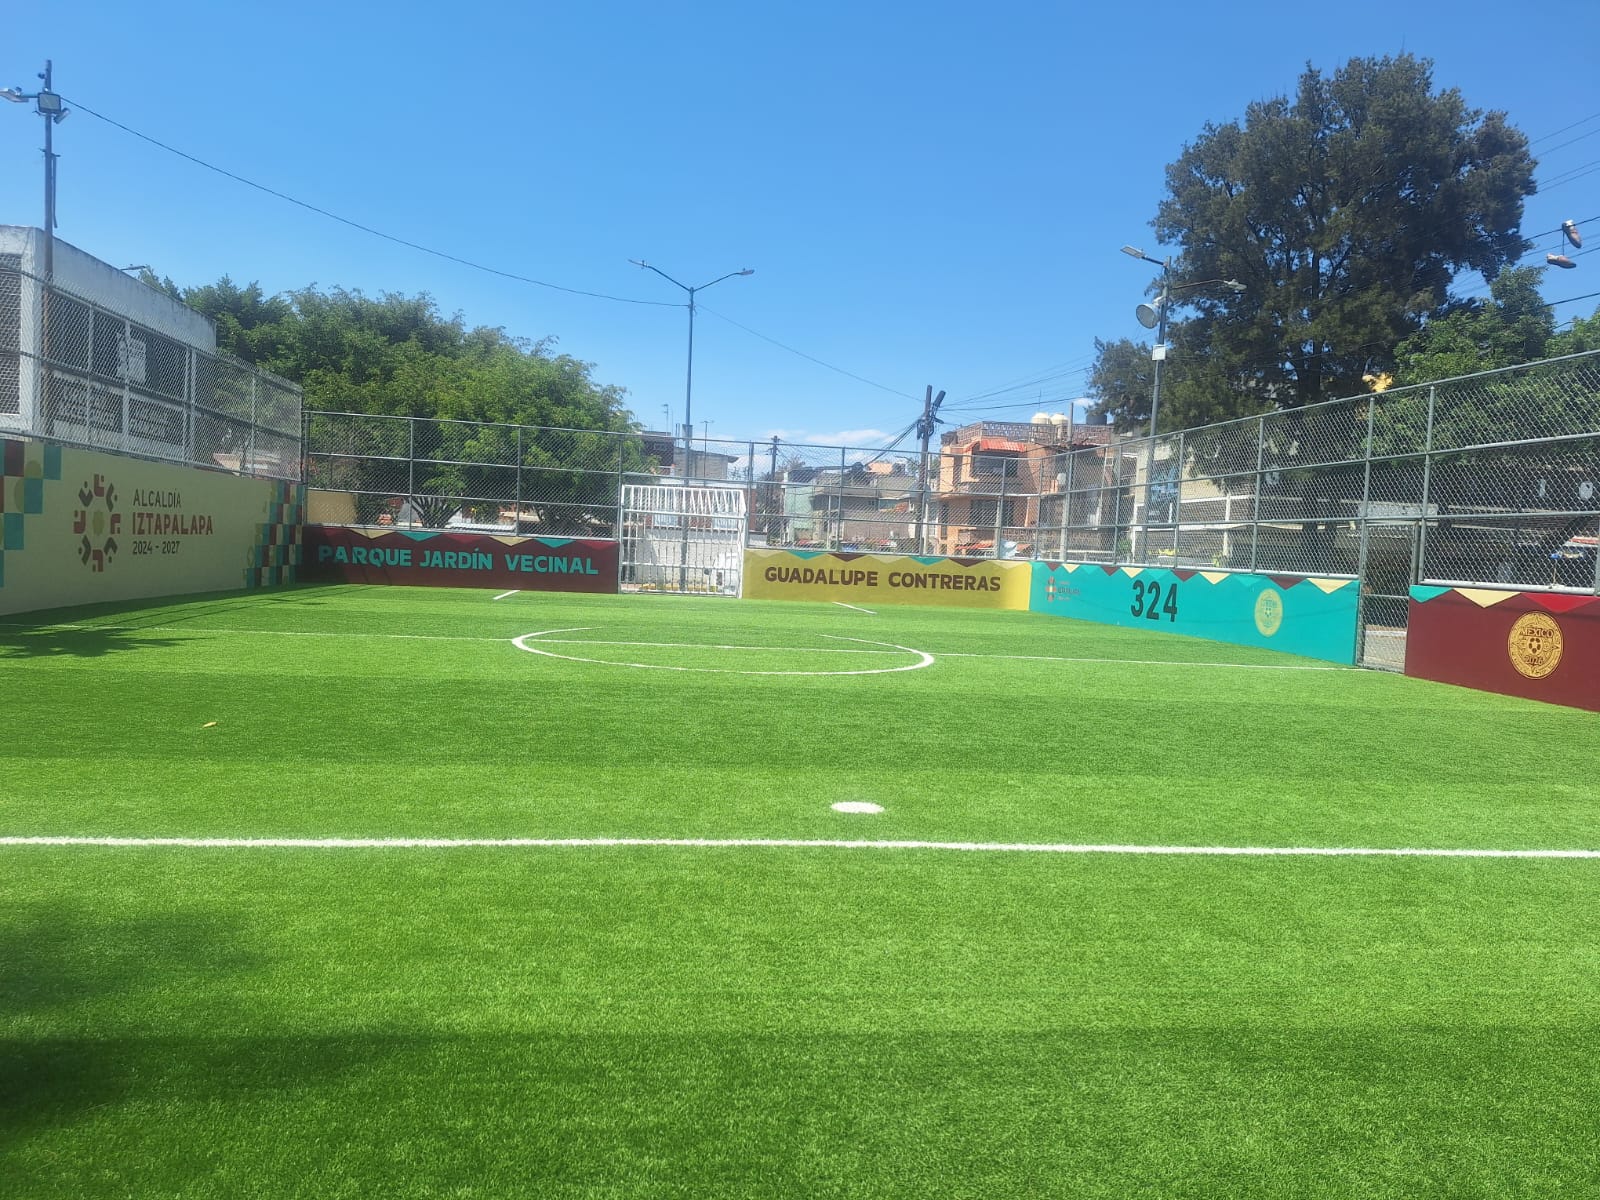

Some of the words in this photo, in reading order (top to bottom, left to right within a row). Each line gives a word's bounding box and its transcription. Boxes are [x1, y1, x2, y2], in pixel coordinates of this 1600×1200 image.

[132, 487, 181, 508] ALCALDÍA
[132, 512, 213, 535] IZTAPALAPA
[132, 541, 152, 554] 2024
[162, 541, 180, 554] 2027
[319, 545, 412, 567] PARQUE
[420, 548, 493, 570] JARDÍN
[505, 554, 599, 575] VECINAL
[765, 566, 878, 587] GUADALUPE
[888, 571, 1001, 592] CONTRERAS
[1130, 580, 1178, 623] 324
